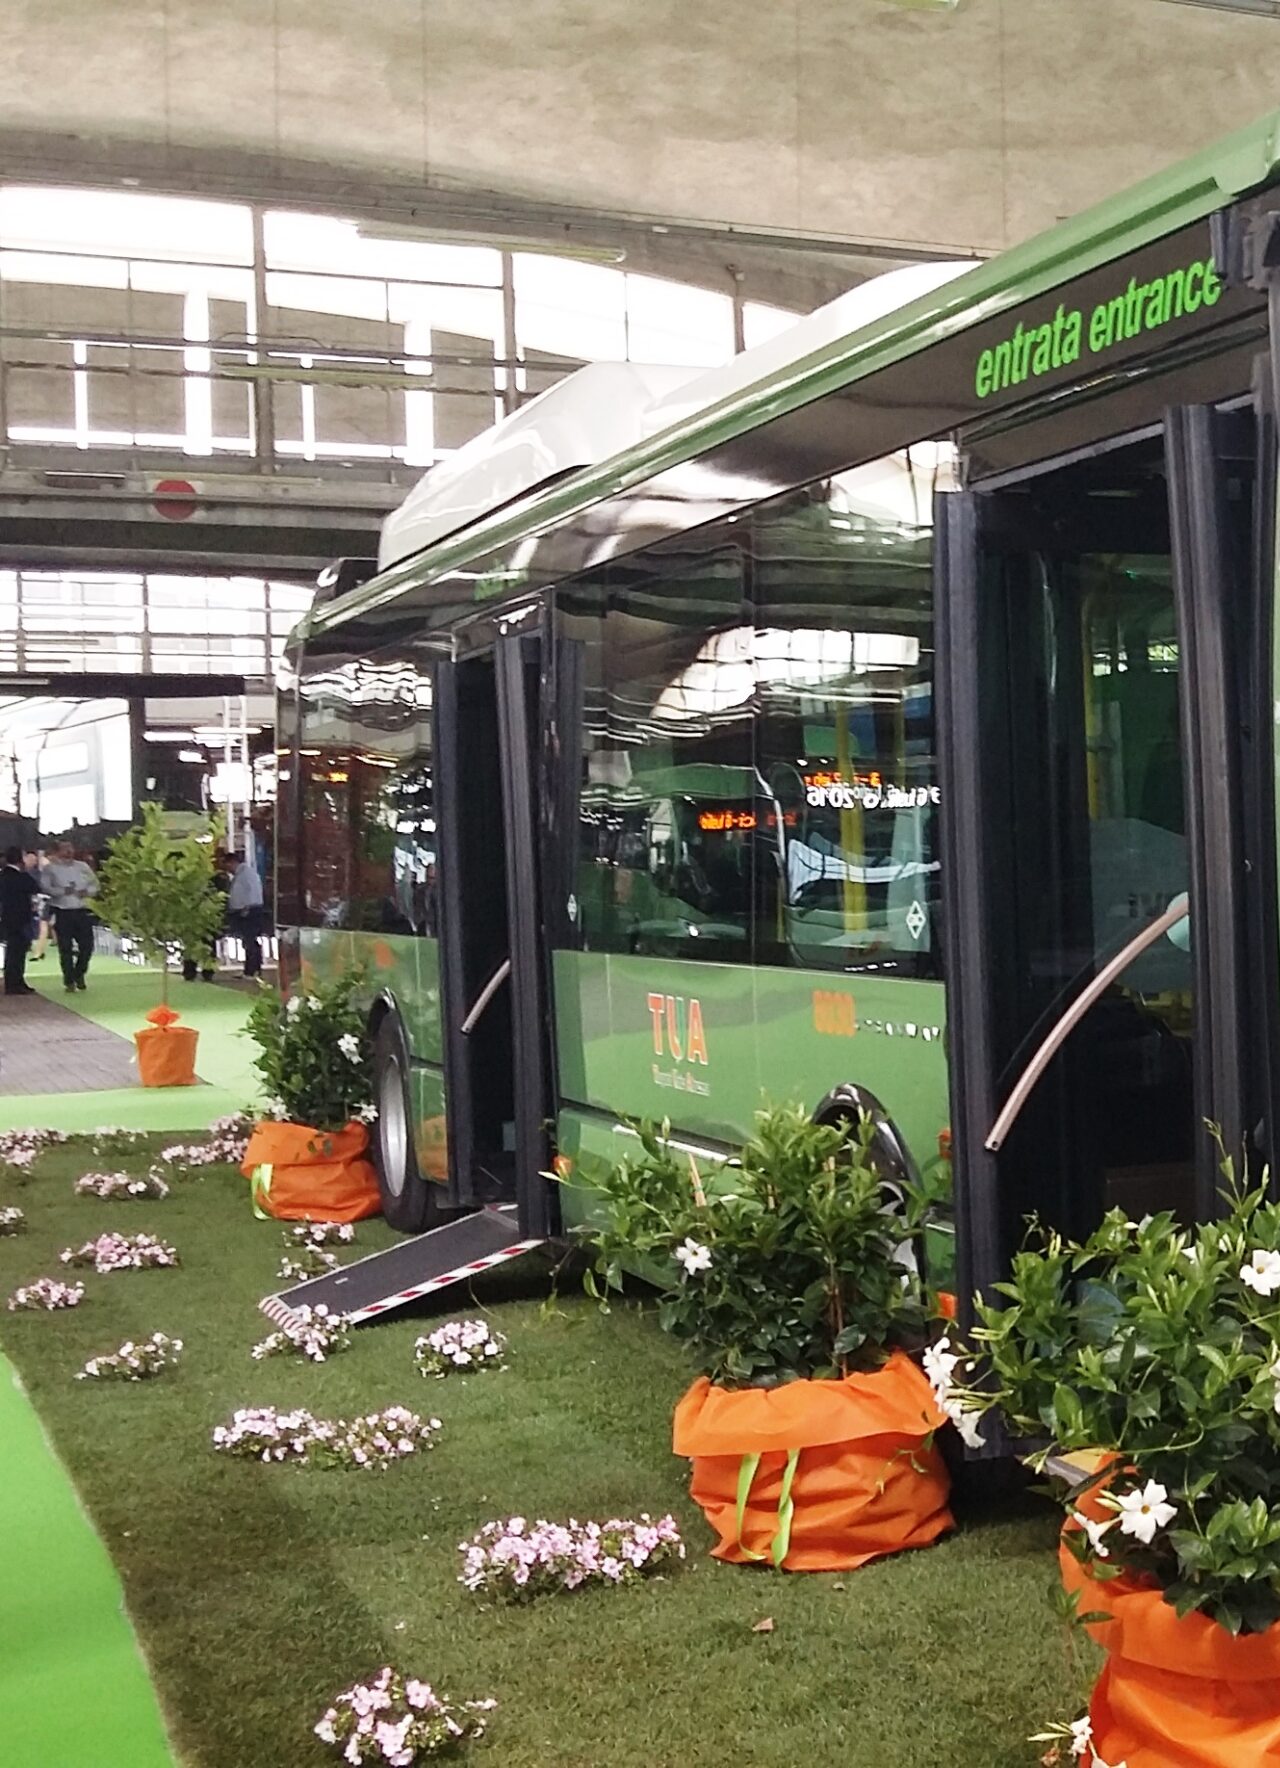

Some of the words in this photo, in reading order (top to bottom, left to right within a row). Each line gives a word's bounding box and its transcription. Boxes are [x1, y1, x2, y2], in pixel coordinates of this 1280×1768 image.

[975, 304, 1082, 398] entrata
[1089, 258, 1222, 353] entrance
[648, 992, 709, 1065] TUA
